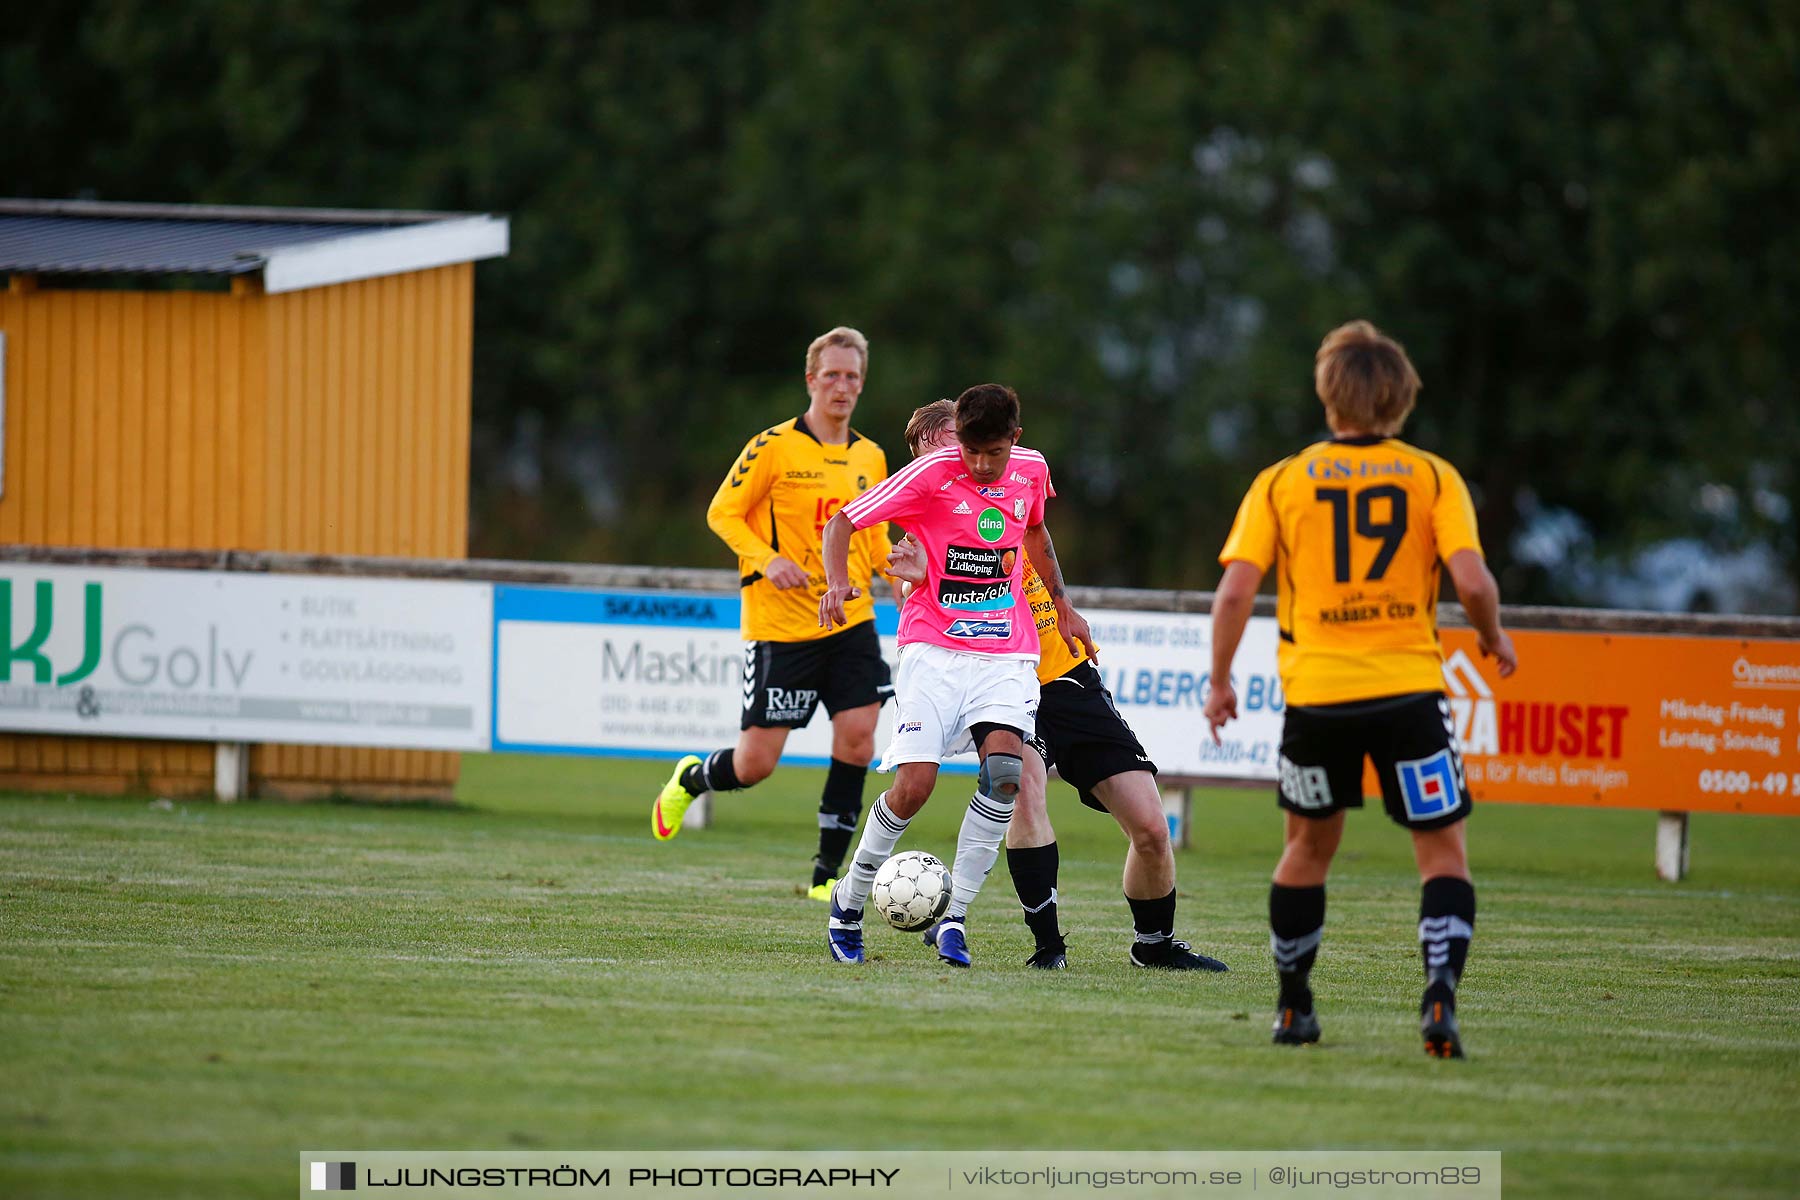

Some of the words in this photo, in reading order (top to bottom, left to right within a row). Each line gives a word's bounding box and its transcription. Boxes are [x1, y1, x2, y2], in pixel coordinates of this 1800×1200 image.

[786, 470, 824, 479] stadium
[980, 519, 1003, 529] dina
[1315, 485, 1407, 583] 19
[947, 548, 997, 562] Sparbanken
[949, 560, 993, 576] Lidköping
[604, 599, 717, 621] SKANSKA
[112, 624, 255, 687] Golv
[76, 684, 100, 720] &
[766, 688, 817, 710] RAPP
